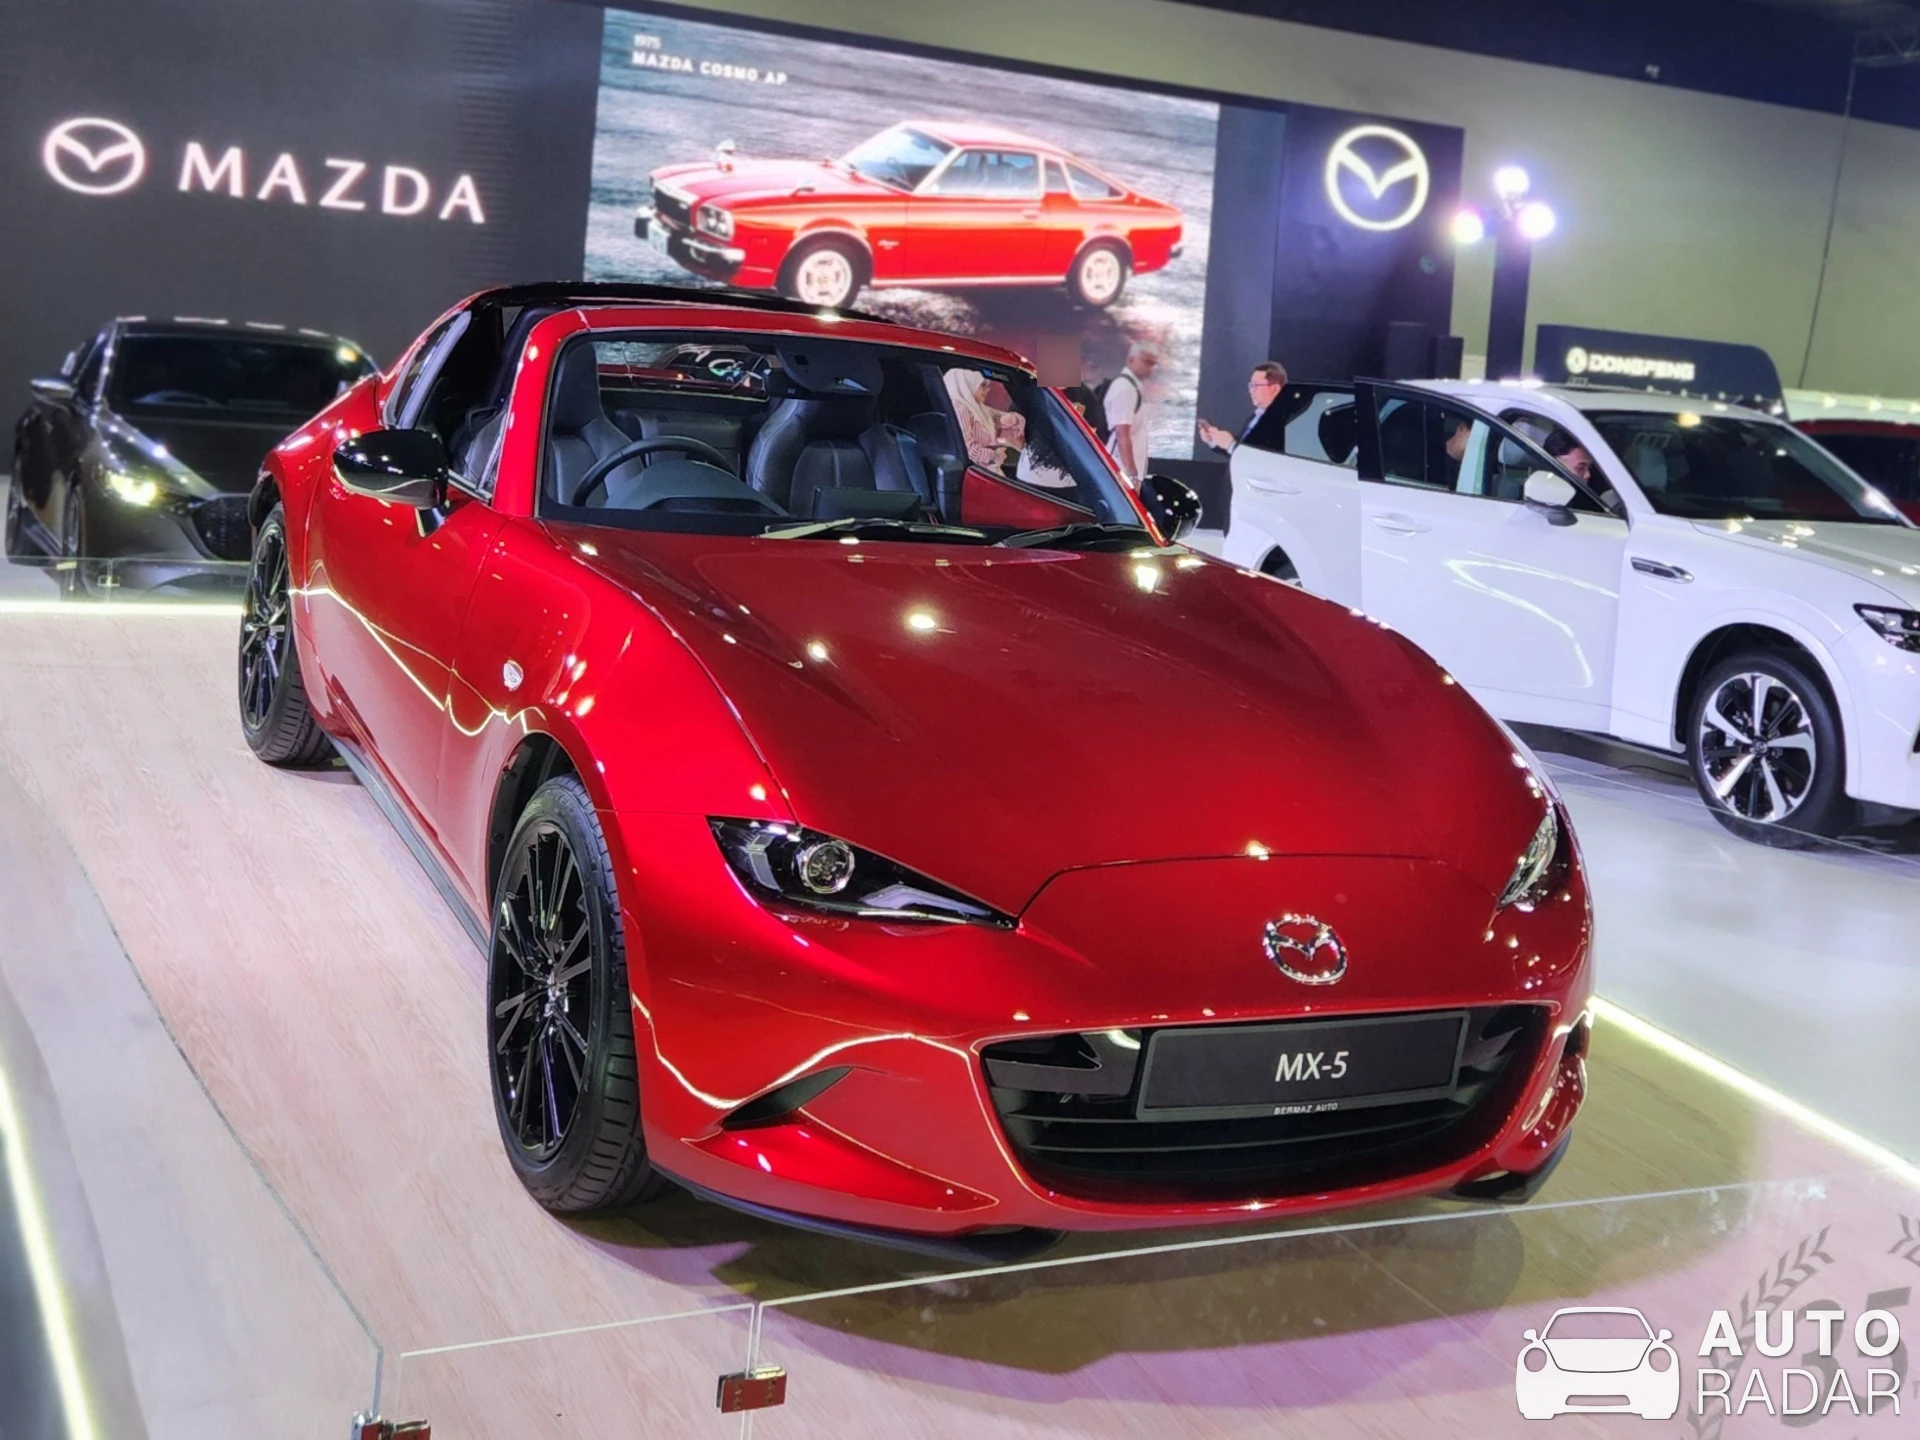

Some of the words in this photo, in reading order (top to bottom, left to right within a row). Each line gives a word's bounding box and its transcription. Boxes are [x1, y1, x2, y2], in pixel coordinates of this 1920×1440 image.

[632, 50, 694, 72] MAZDA
[700, 61, 758, 82] COSMO
[764, 71, 788, 86] AP
[178, 141, 485, 224] MAZDA
[1588, 353, 1696, 382] DONGFENG
[1275, 1051, 1349, 1082] MX-5
[1273, 1104, 1313, 1116] BERMAZ
[1315, 1102, 1338, 1113] AUTO
